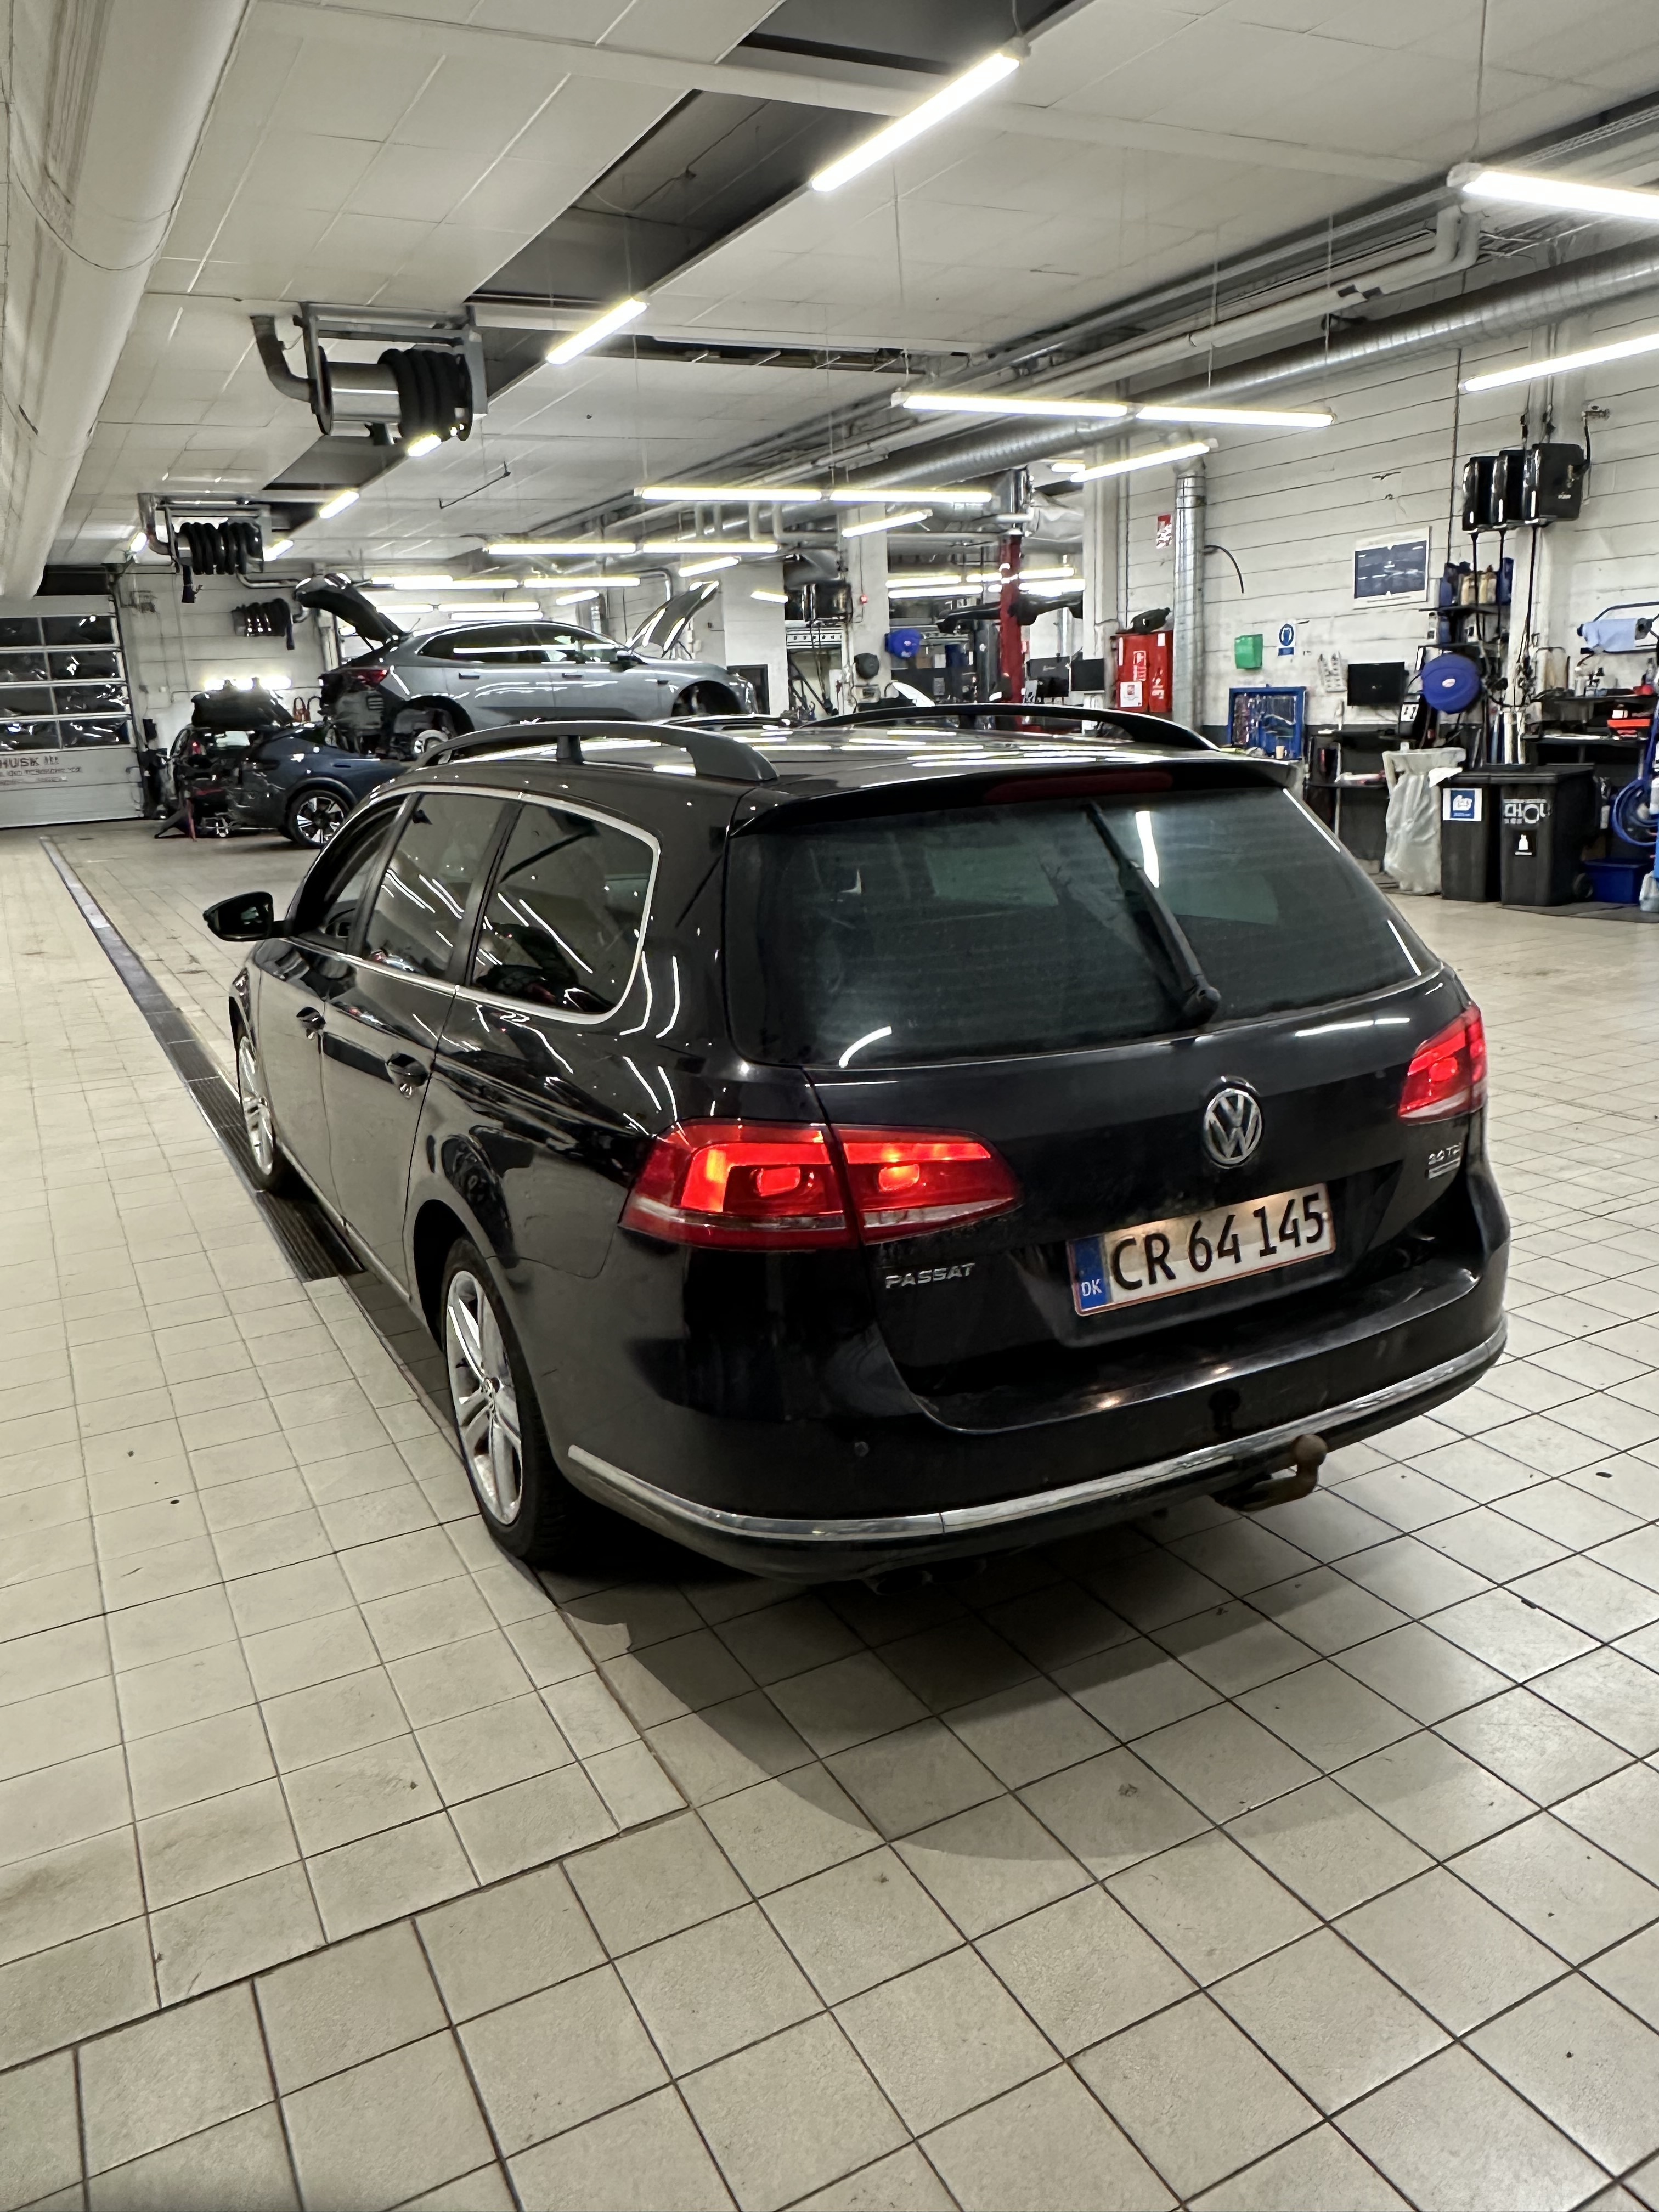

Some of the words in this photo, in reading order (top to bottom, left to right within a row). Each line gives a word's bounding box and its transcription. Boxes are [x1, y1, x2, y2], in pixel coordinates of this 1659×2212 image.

[1204, 1088, 1262, 1164] VW
[1111, 1232, 1176, 1291] CR
[1188, 1213, 1242, 1272] 64
[1253, 1192, 1324, 1258] 145
[885, 1262, 976, 1289] PASSAT
[1081, 1278, 1102, 1297] DK
